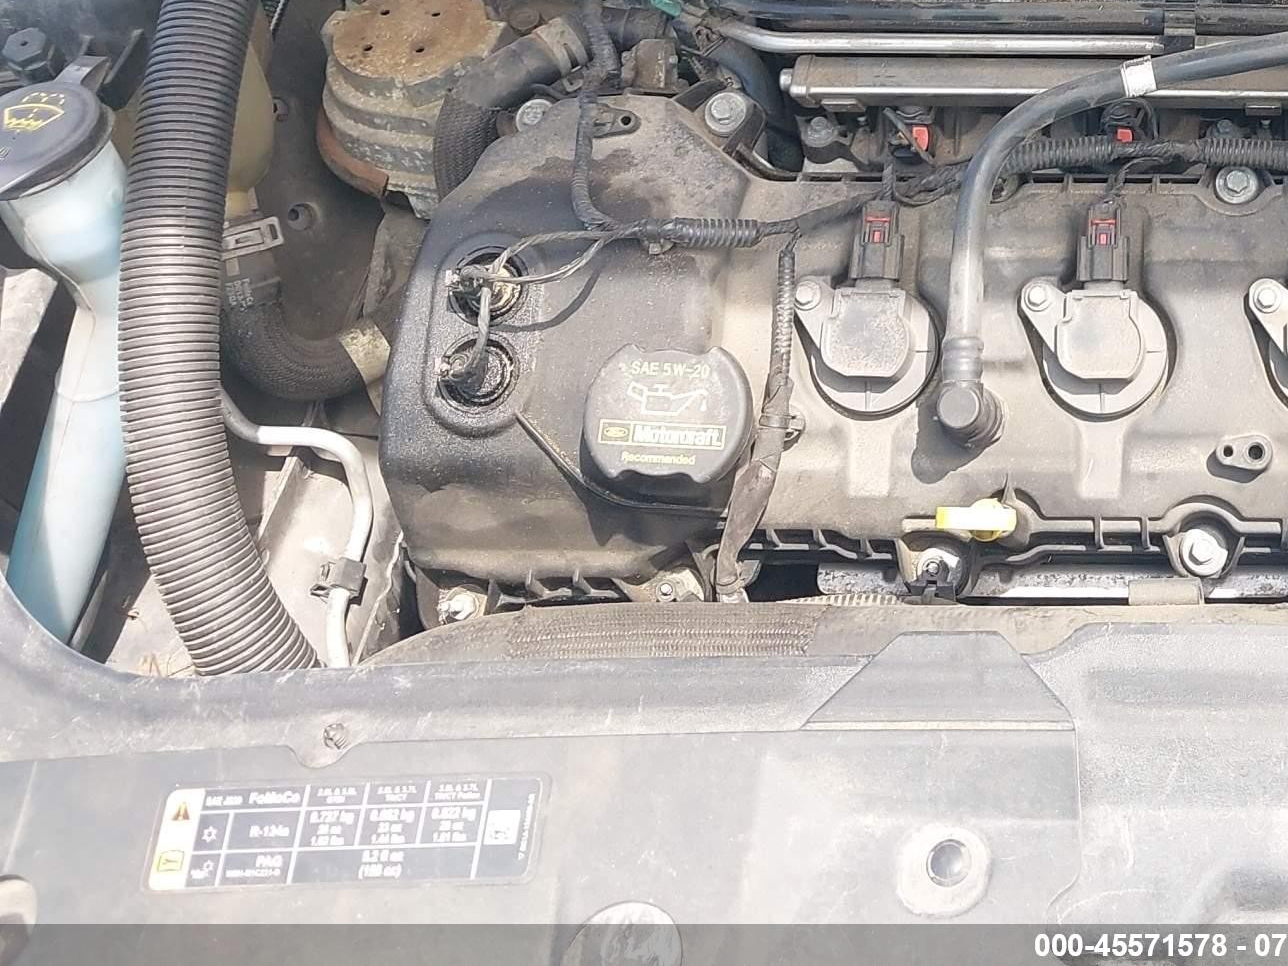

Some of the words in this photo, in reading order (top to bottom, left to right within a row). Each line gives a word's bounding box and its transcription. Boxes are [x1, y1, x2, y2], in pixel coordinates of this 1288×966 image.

[631, 360, 658, 376] SAE
[663, 363, 710, 379] 5W-20
[634, 425, 722, 447] Motorcraft
[621, 451, 696, 465] Recommended
